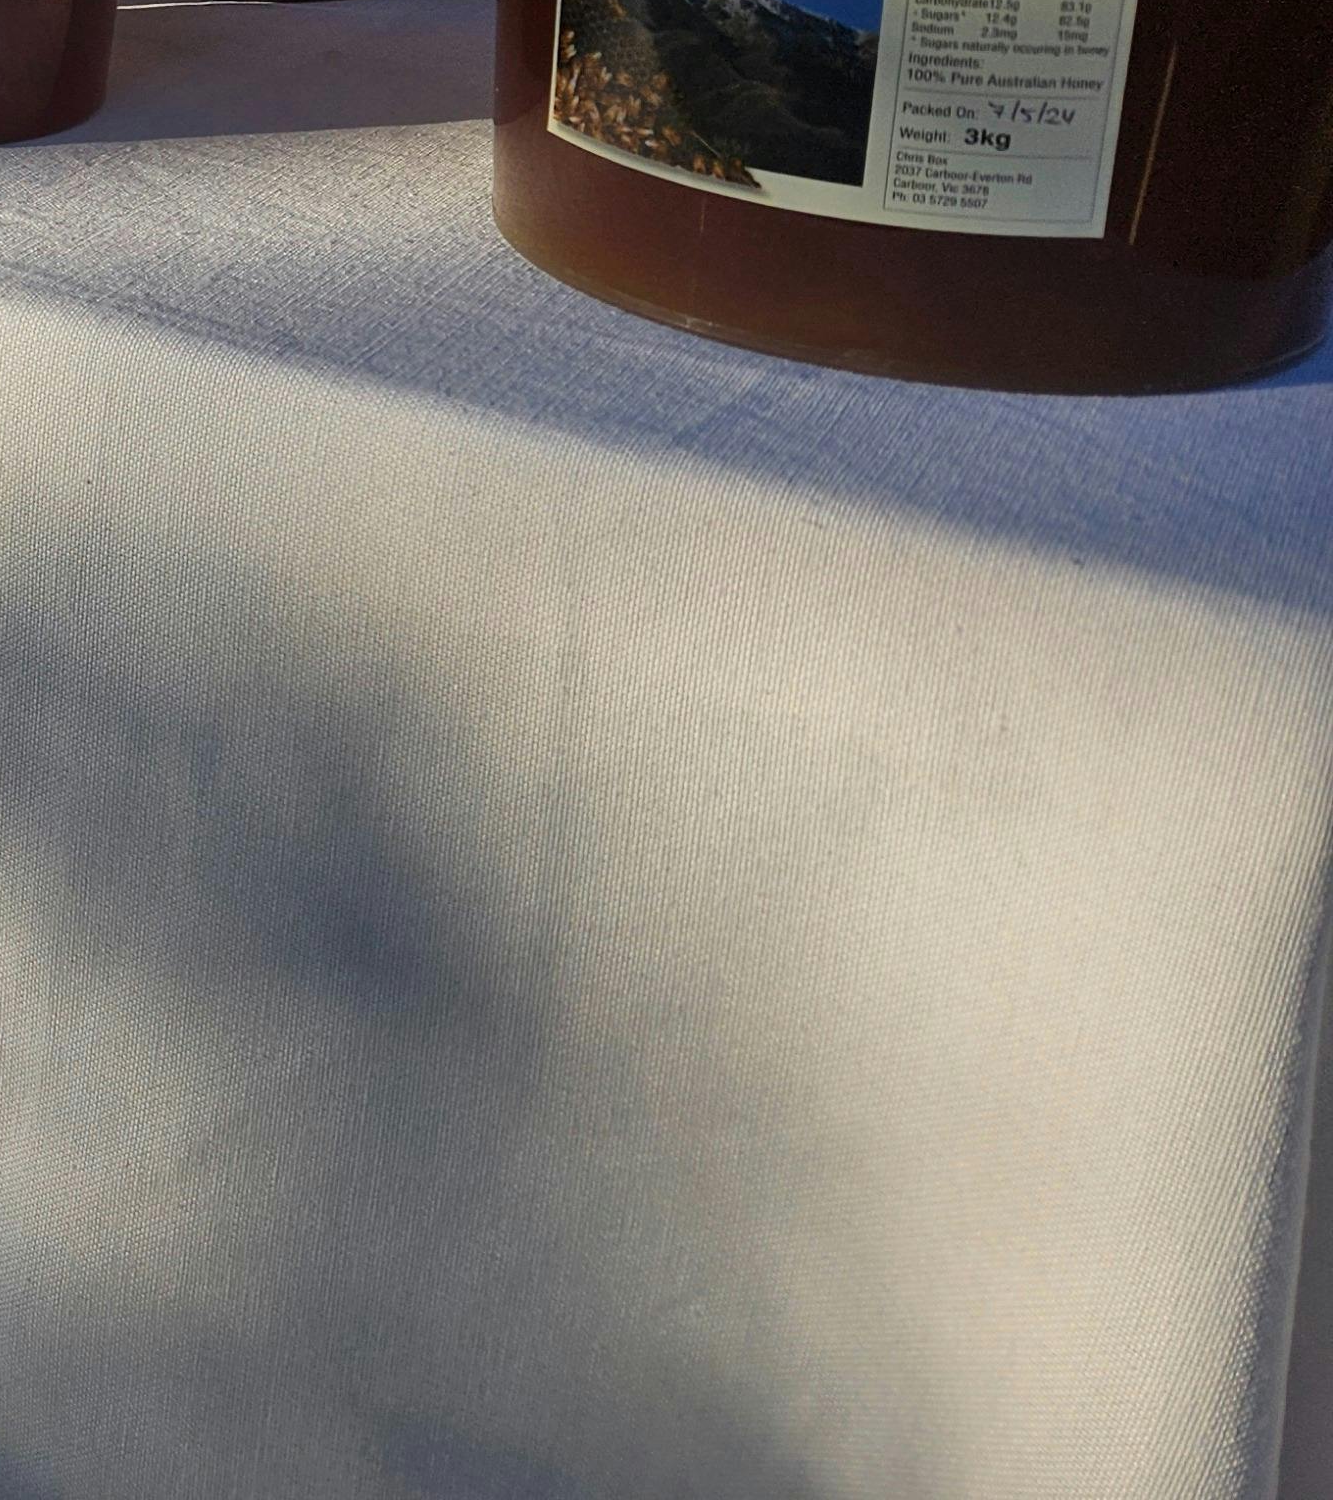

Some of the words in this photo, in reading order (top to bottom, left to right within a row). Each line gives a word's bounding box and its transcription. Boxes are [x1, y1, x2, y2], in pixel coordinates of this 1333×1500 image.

[908, 68, 946, 84] 100%
[951, 72, 984, 86] Pure
[987, 74, 1057, 90] Australian
[1060, 76, 1104, 91] Honey
[902, 101, 952, 118] Packed
[899, 126, 950, 144] Weight:
[964, 127, 1012, 151] 3kg
[896, 151, 925, 164] Chris
[895, 165, 922, 178] 2037
